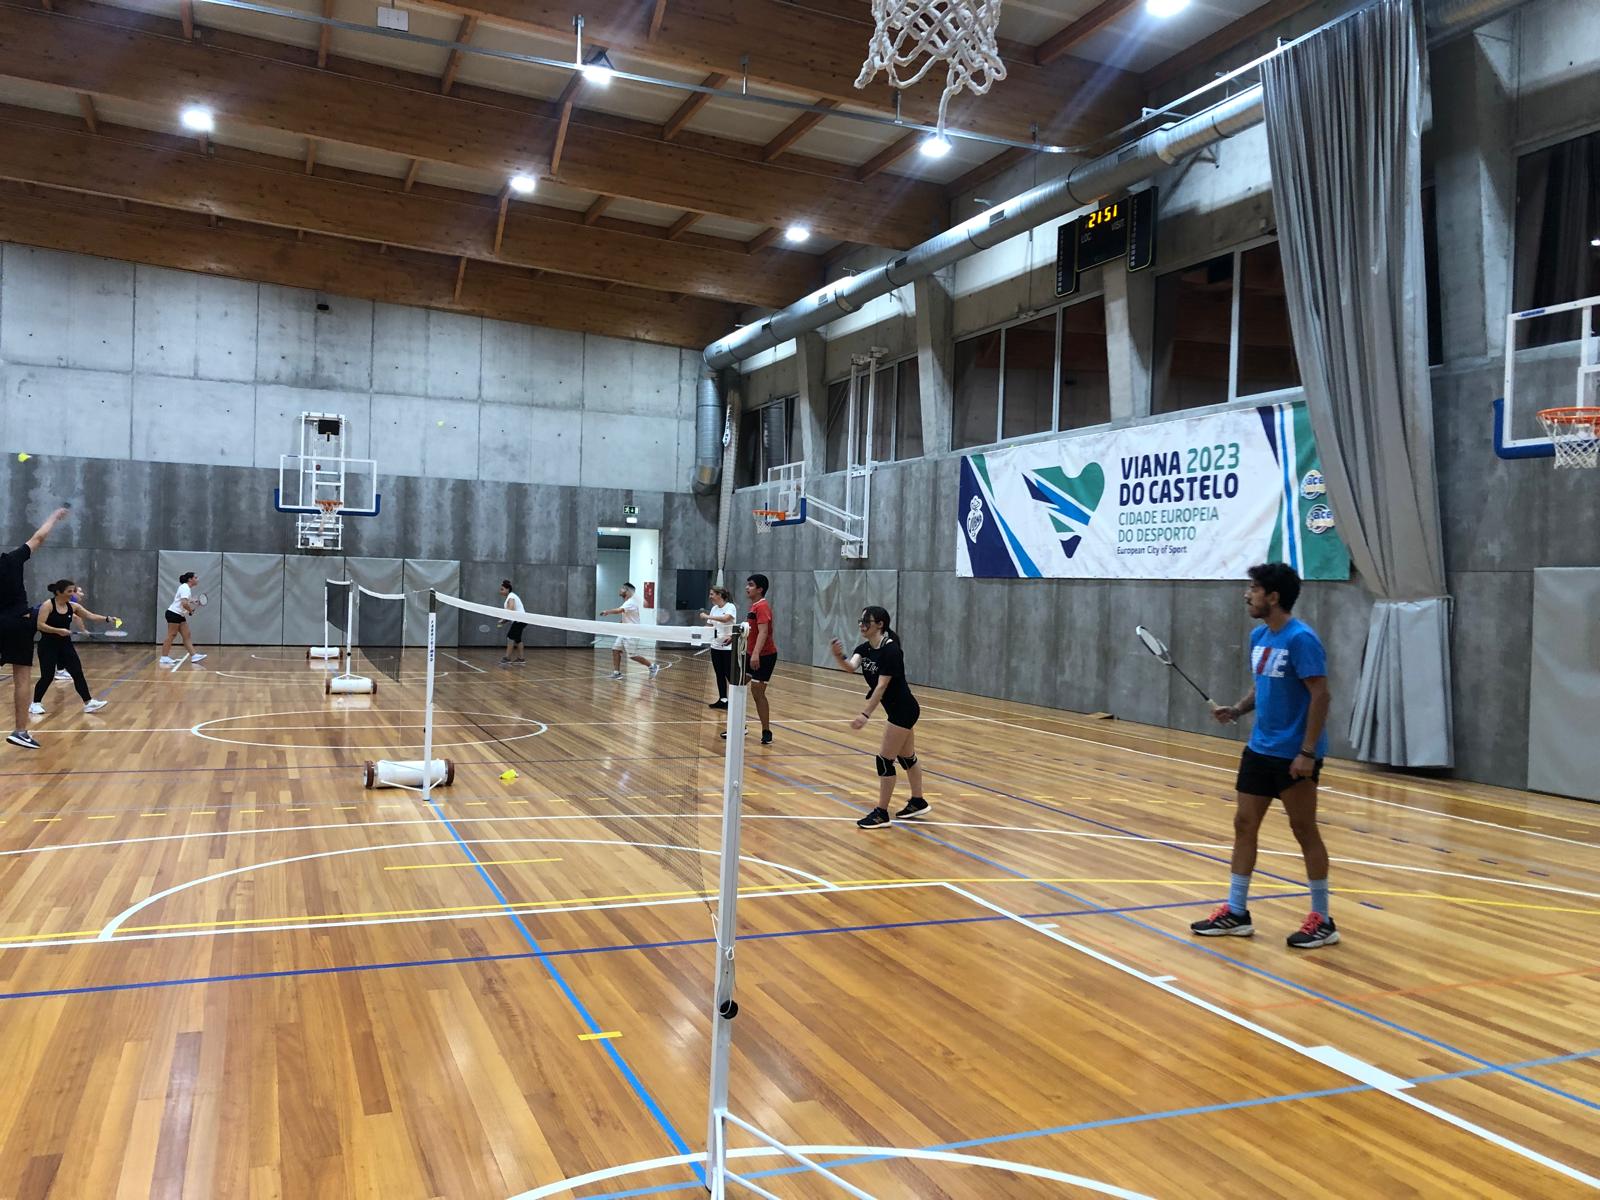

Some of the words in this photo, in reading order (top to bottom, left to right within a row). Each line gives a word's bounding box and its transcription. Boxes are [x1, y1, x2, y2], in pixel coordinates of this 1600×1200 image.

[1121, 450, 1181, 480] VIANA
[1187, 442, 1239, 473] 2023
[1119, 481, 1145, 507] DO
[1149, 472, 1239, 504] CASTELO
[1119, 510, 1158, 526] CIDADE
[1161, 506, 1219, 524] EUROPEIA
[1118, 528, 1133, 542] DO
[1137, 526, 1197, 542] DESPORTO
[1117, 546, 1145, 555] European
[1147, 545, 1160, 556] City
[1161, 545, 1167, 554] of
[1169, 545, 1187, 556] Sport
